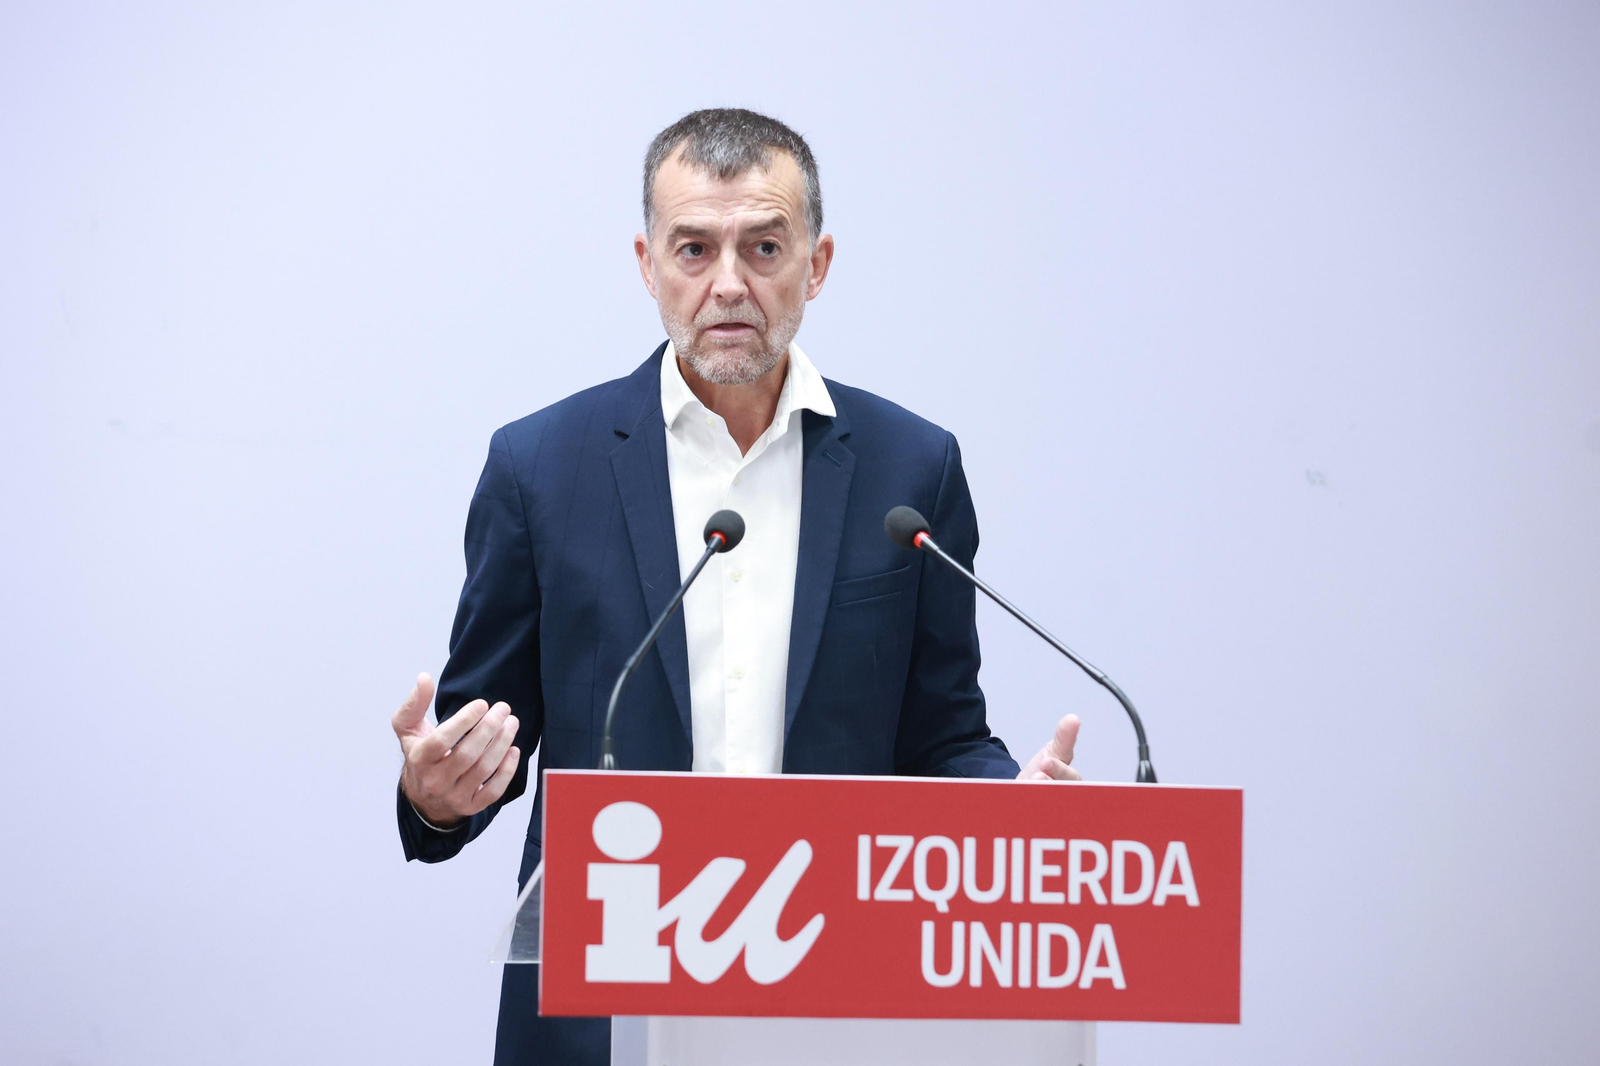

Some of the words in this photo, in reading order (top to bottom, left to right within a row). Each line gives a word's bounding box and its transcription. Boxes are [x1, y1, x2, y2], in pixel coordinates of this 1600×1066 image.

[585, 802, 824, 985] iu
[857, 834, 1199, 912] IZQUIERDA
[921, 920, 1126, 990] UNIDA
